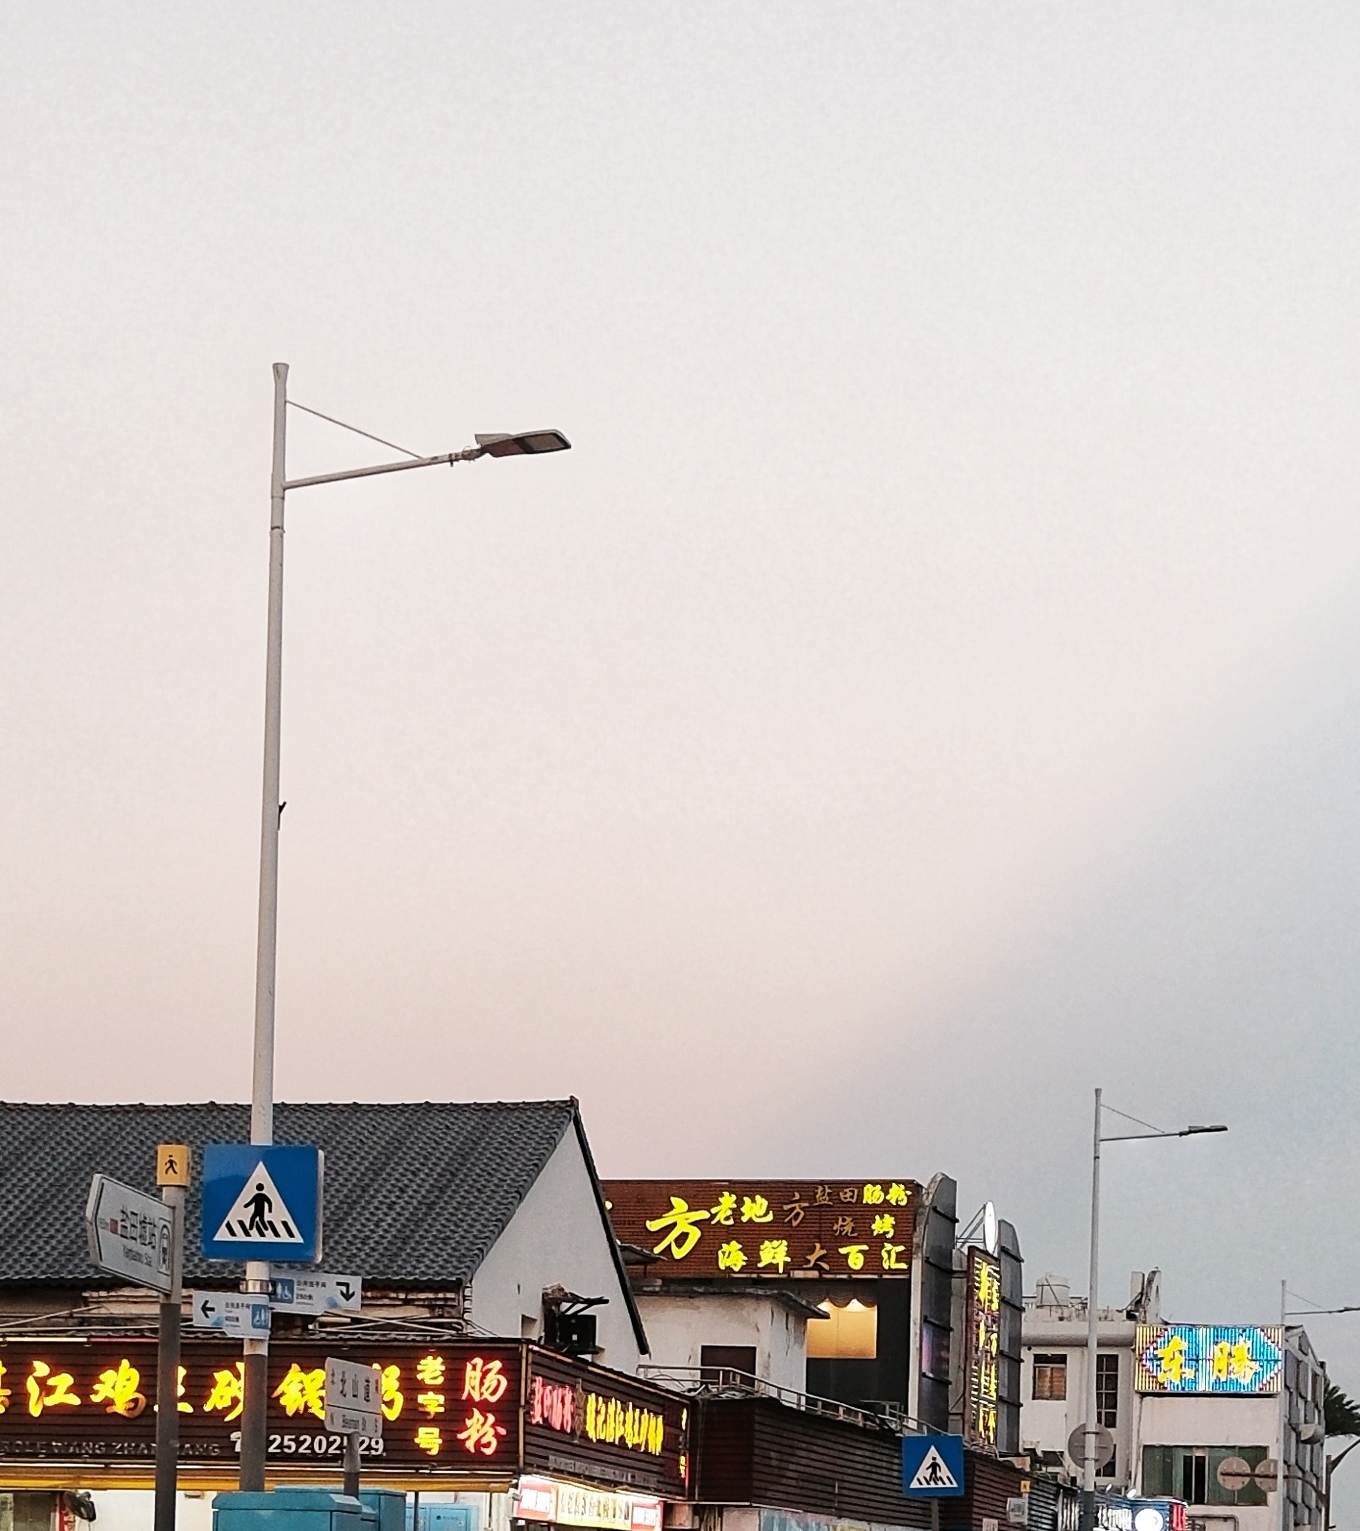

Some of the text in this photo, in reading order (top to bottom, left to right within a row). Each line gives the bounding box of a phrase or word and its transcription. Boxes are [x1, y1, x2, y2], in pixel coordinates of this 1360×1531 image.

[810, 1183, 913, 1207] 盐田肠粉
[832, 1213, 897, 1239] 烧烤
[414, 1355, 446, 1456] 老字号
[457, 1356, 508, 1456] 肠粉
